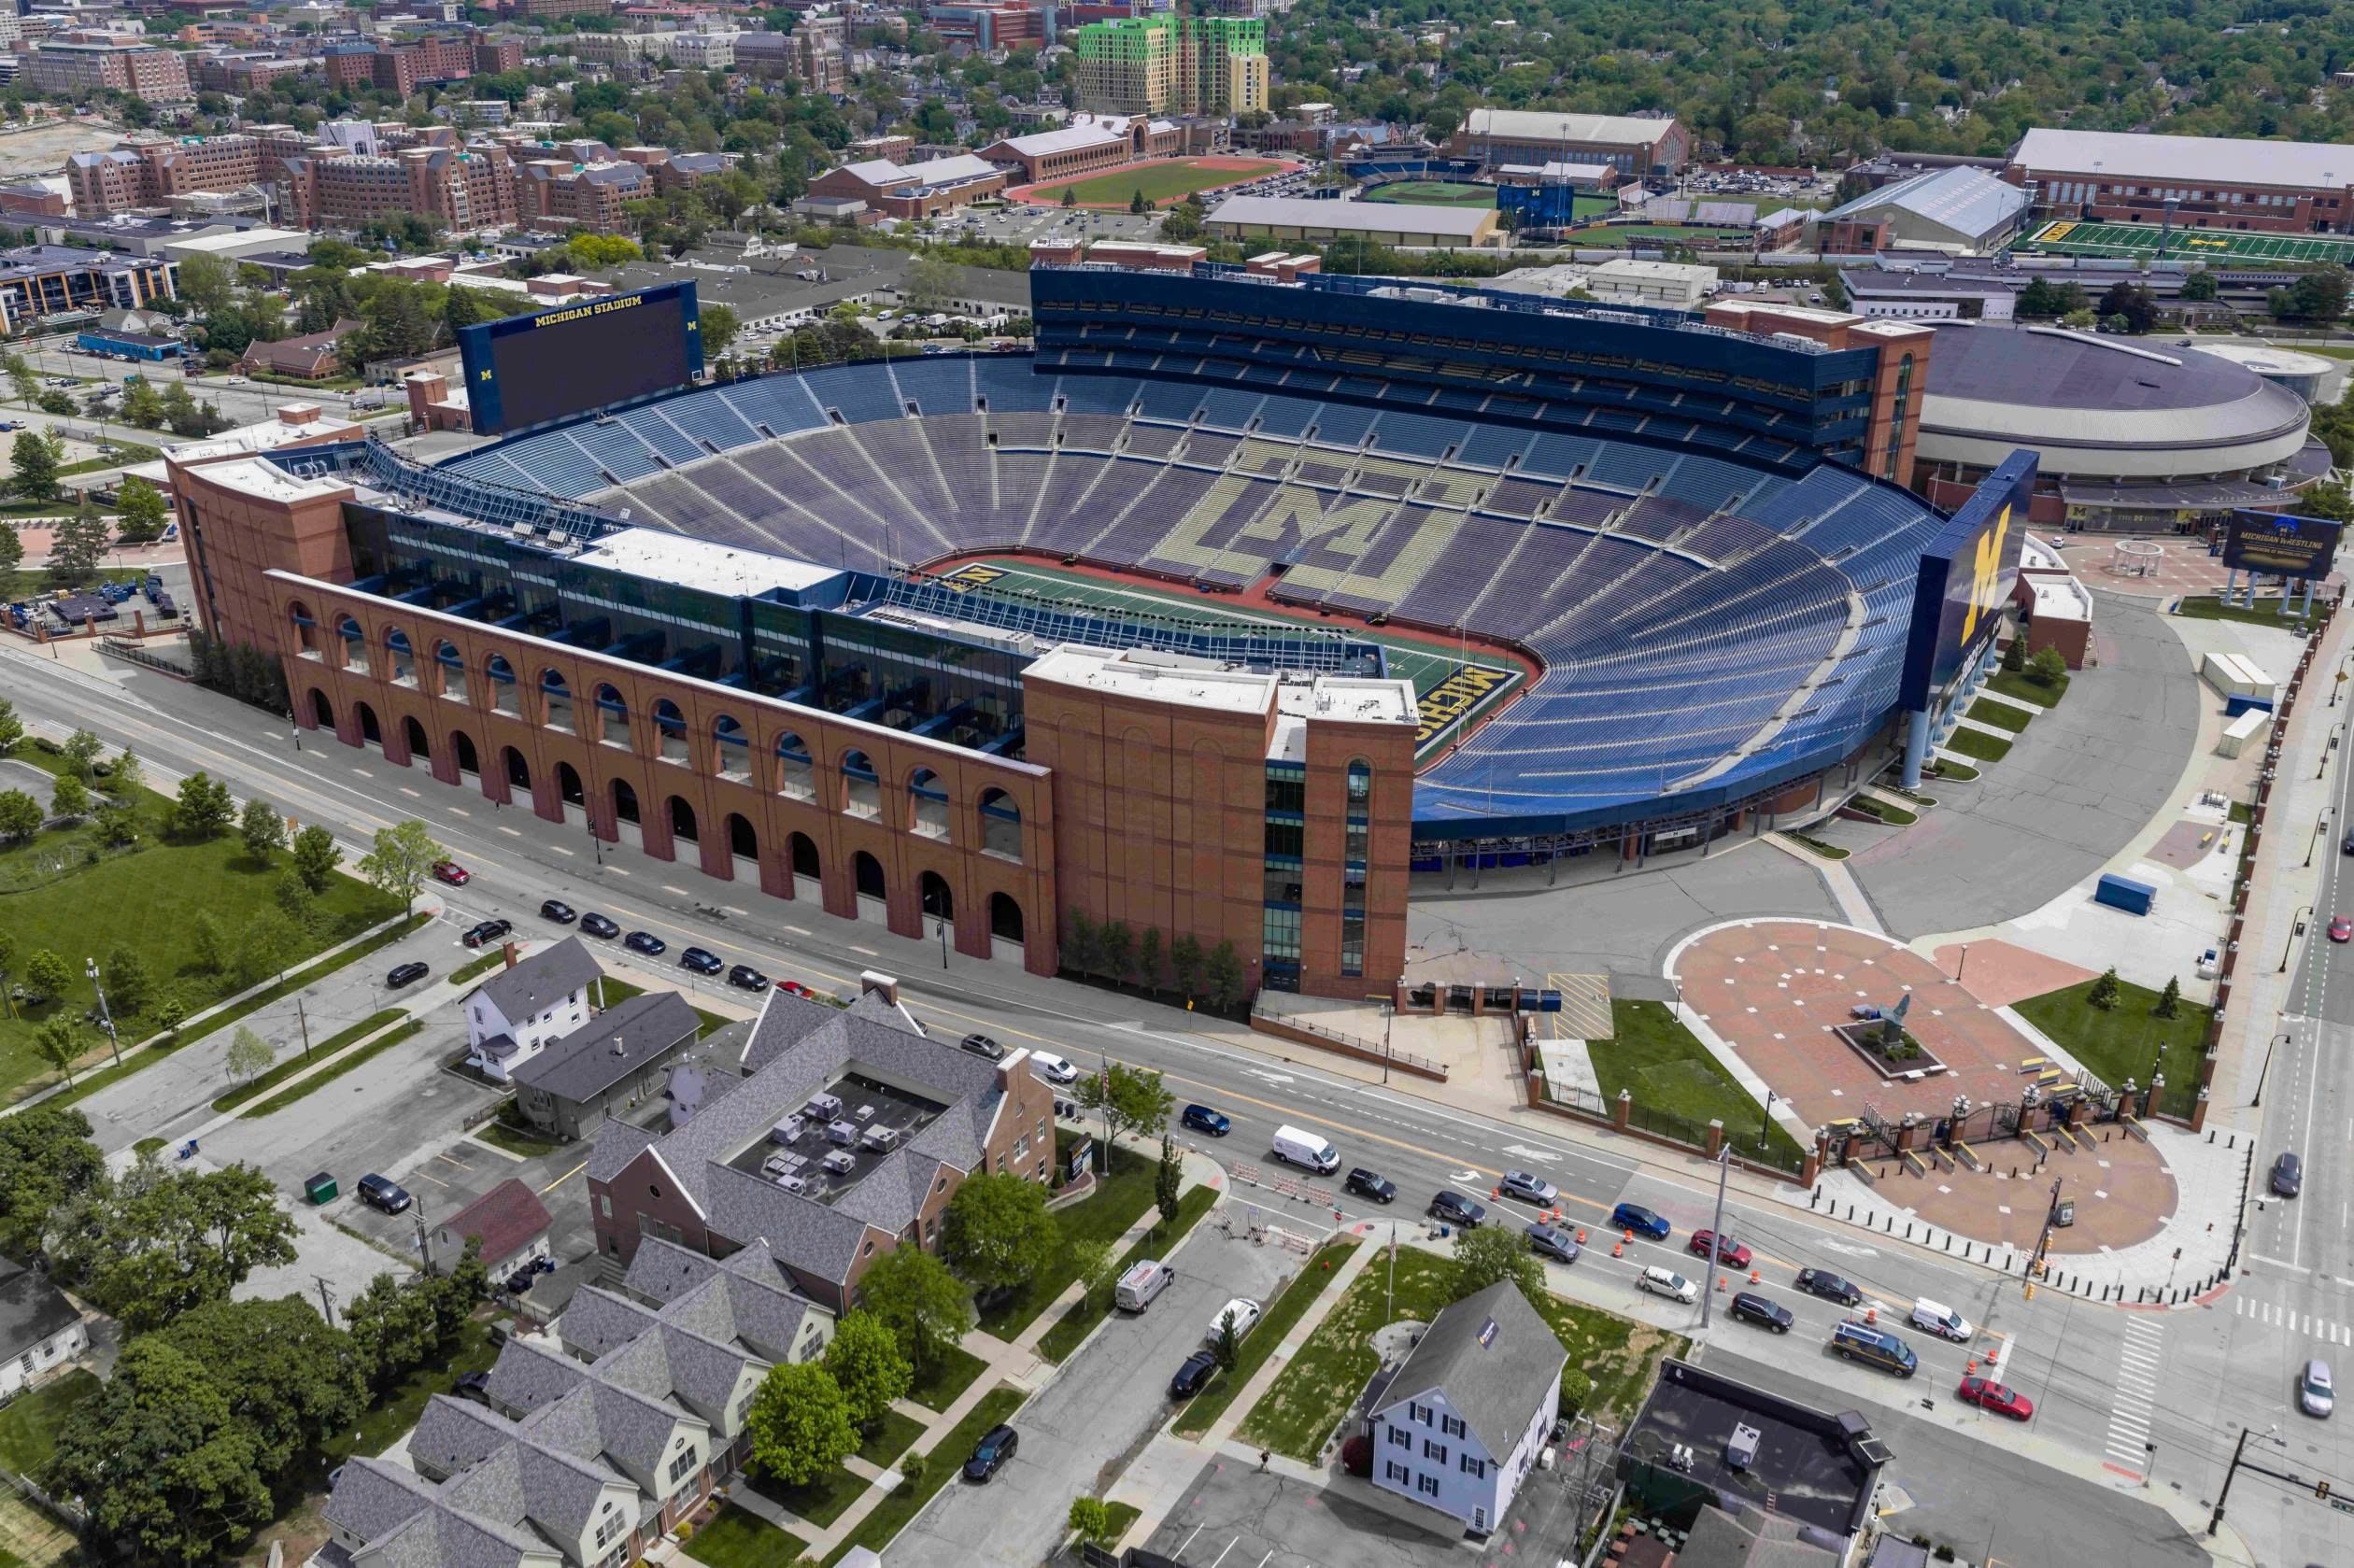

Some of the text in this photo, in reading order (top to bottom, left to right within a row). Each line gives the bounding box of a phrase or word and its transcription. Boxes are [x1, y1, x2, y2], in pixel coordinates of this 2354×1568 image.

[535, 295, 642, 328] MICHIGAN STADIUM
[687, 320, 697, 332] M
[480, 369, 492, 381] M
[2073, 506, 2087, 516] M
[2240, 531, 2279, 544] MICHIGAN
[2280, 537, 2324, 549] WRESTLING
[1961, 502, 2011, 646] M
